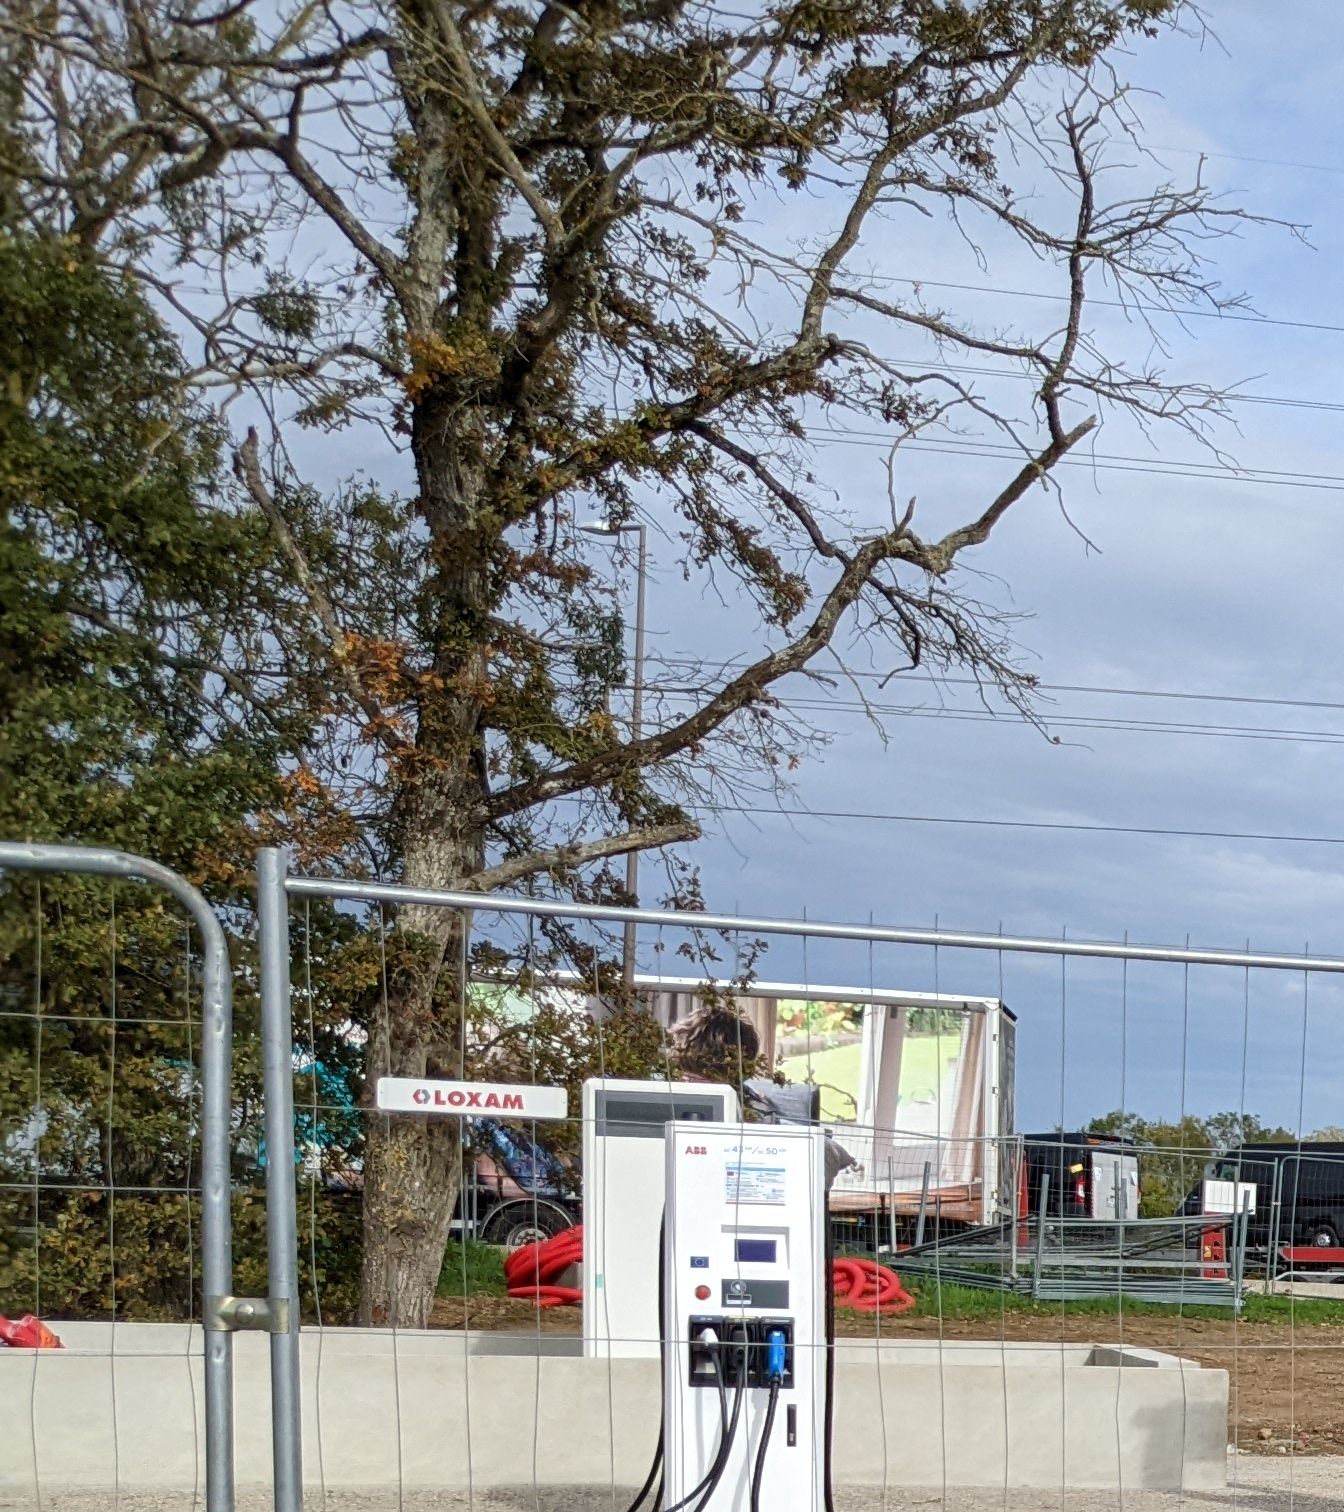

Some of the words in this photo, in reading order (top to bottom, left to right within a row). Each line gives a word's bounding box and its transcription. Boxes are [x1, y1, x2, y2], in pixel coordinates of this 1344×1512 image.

[434, 1090, 524, 1110] LOXAM
[685, 1146, 707, 1155] ABB
[766, 1147, 778, 1155] 50
